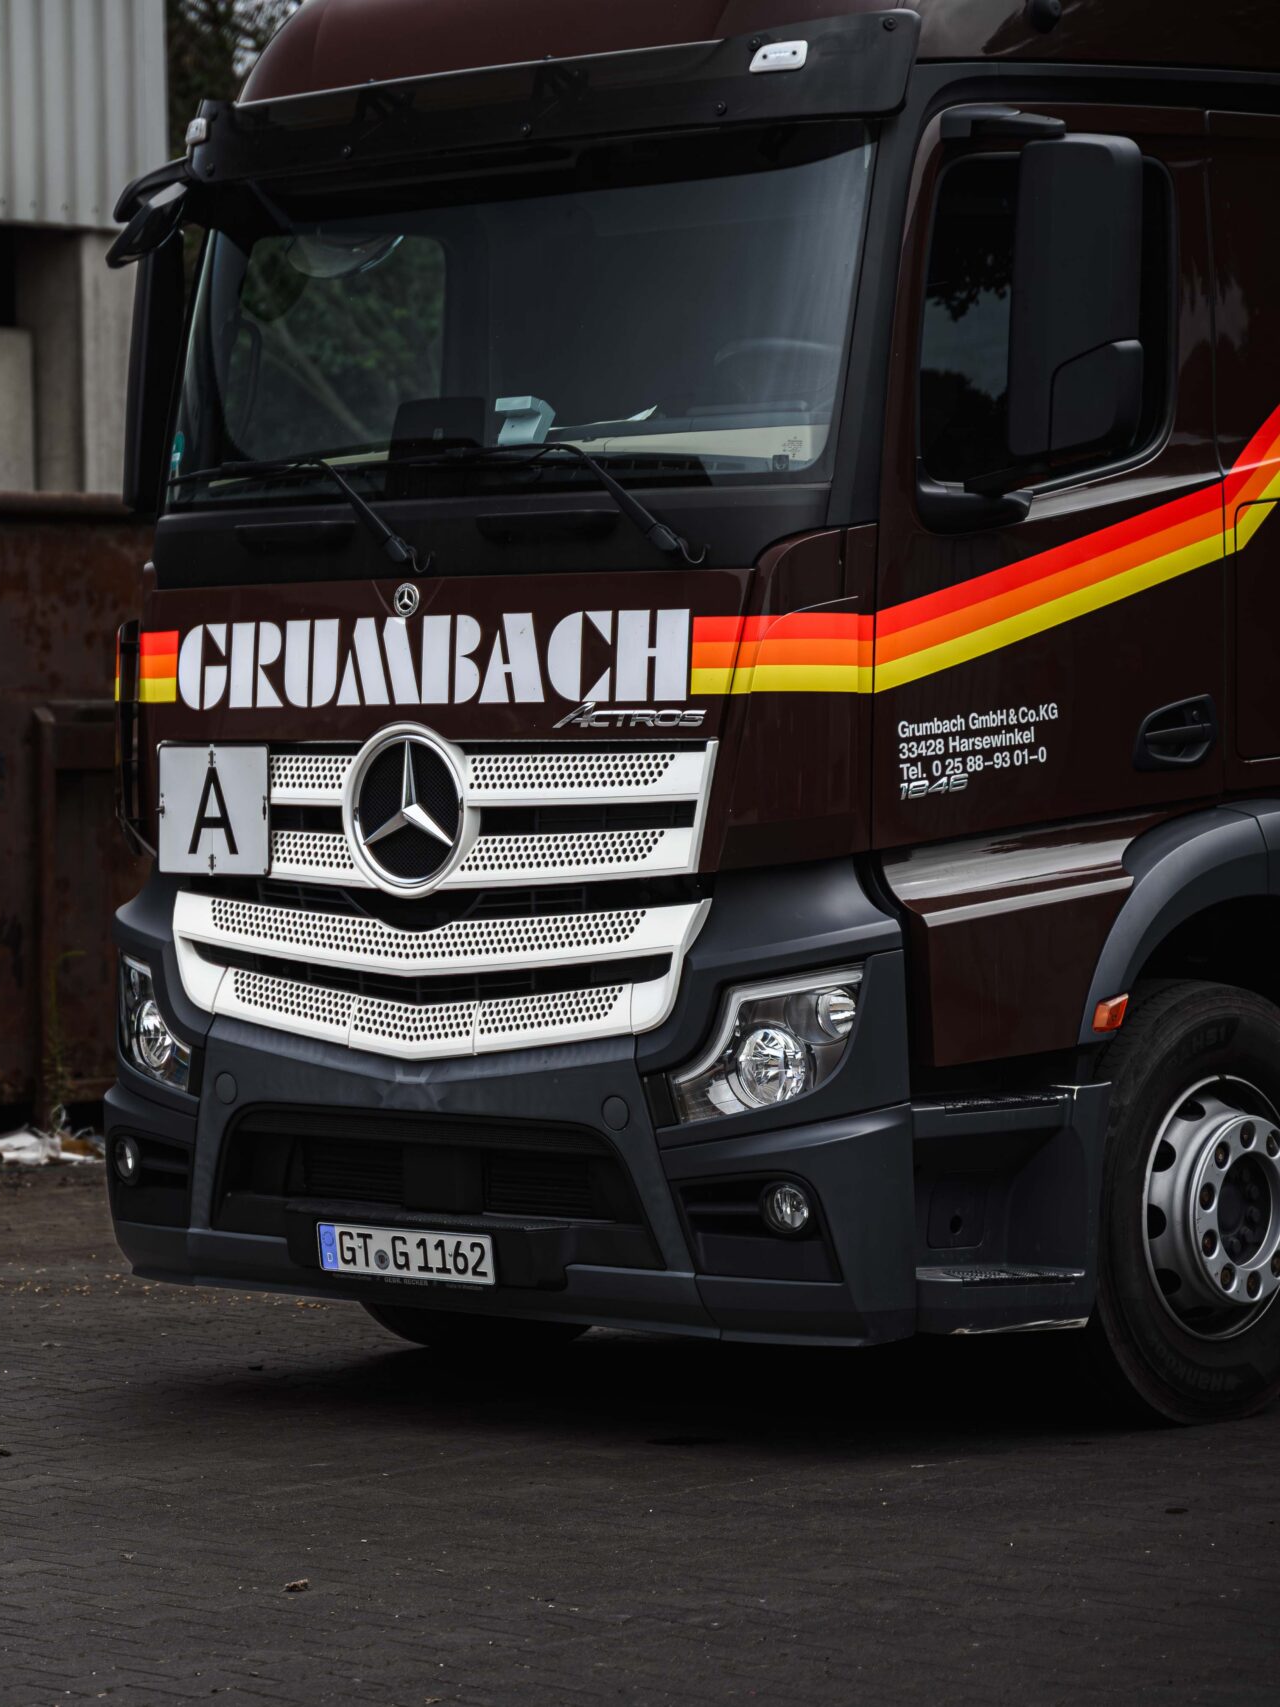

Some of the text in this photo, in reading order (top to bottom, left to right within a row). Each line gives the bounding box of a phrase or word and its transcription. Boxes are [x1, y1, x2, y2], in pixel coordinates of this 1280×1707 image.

[178, 608, 690, 710] GRUMBACH
[898, 702, 1058, 738] Grumbach GmbH & Co.KG
[899, 726, 1035, 759] 33428 Harsewinkel
[899, 761, 927, 781] Tel.
[900, 773, 969, 800] 1846
[188, 766, 239, 855] A
[338, 1230, 373, 1267] GT
